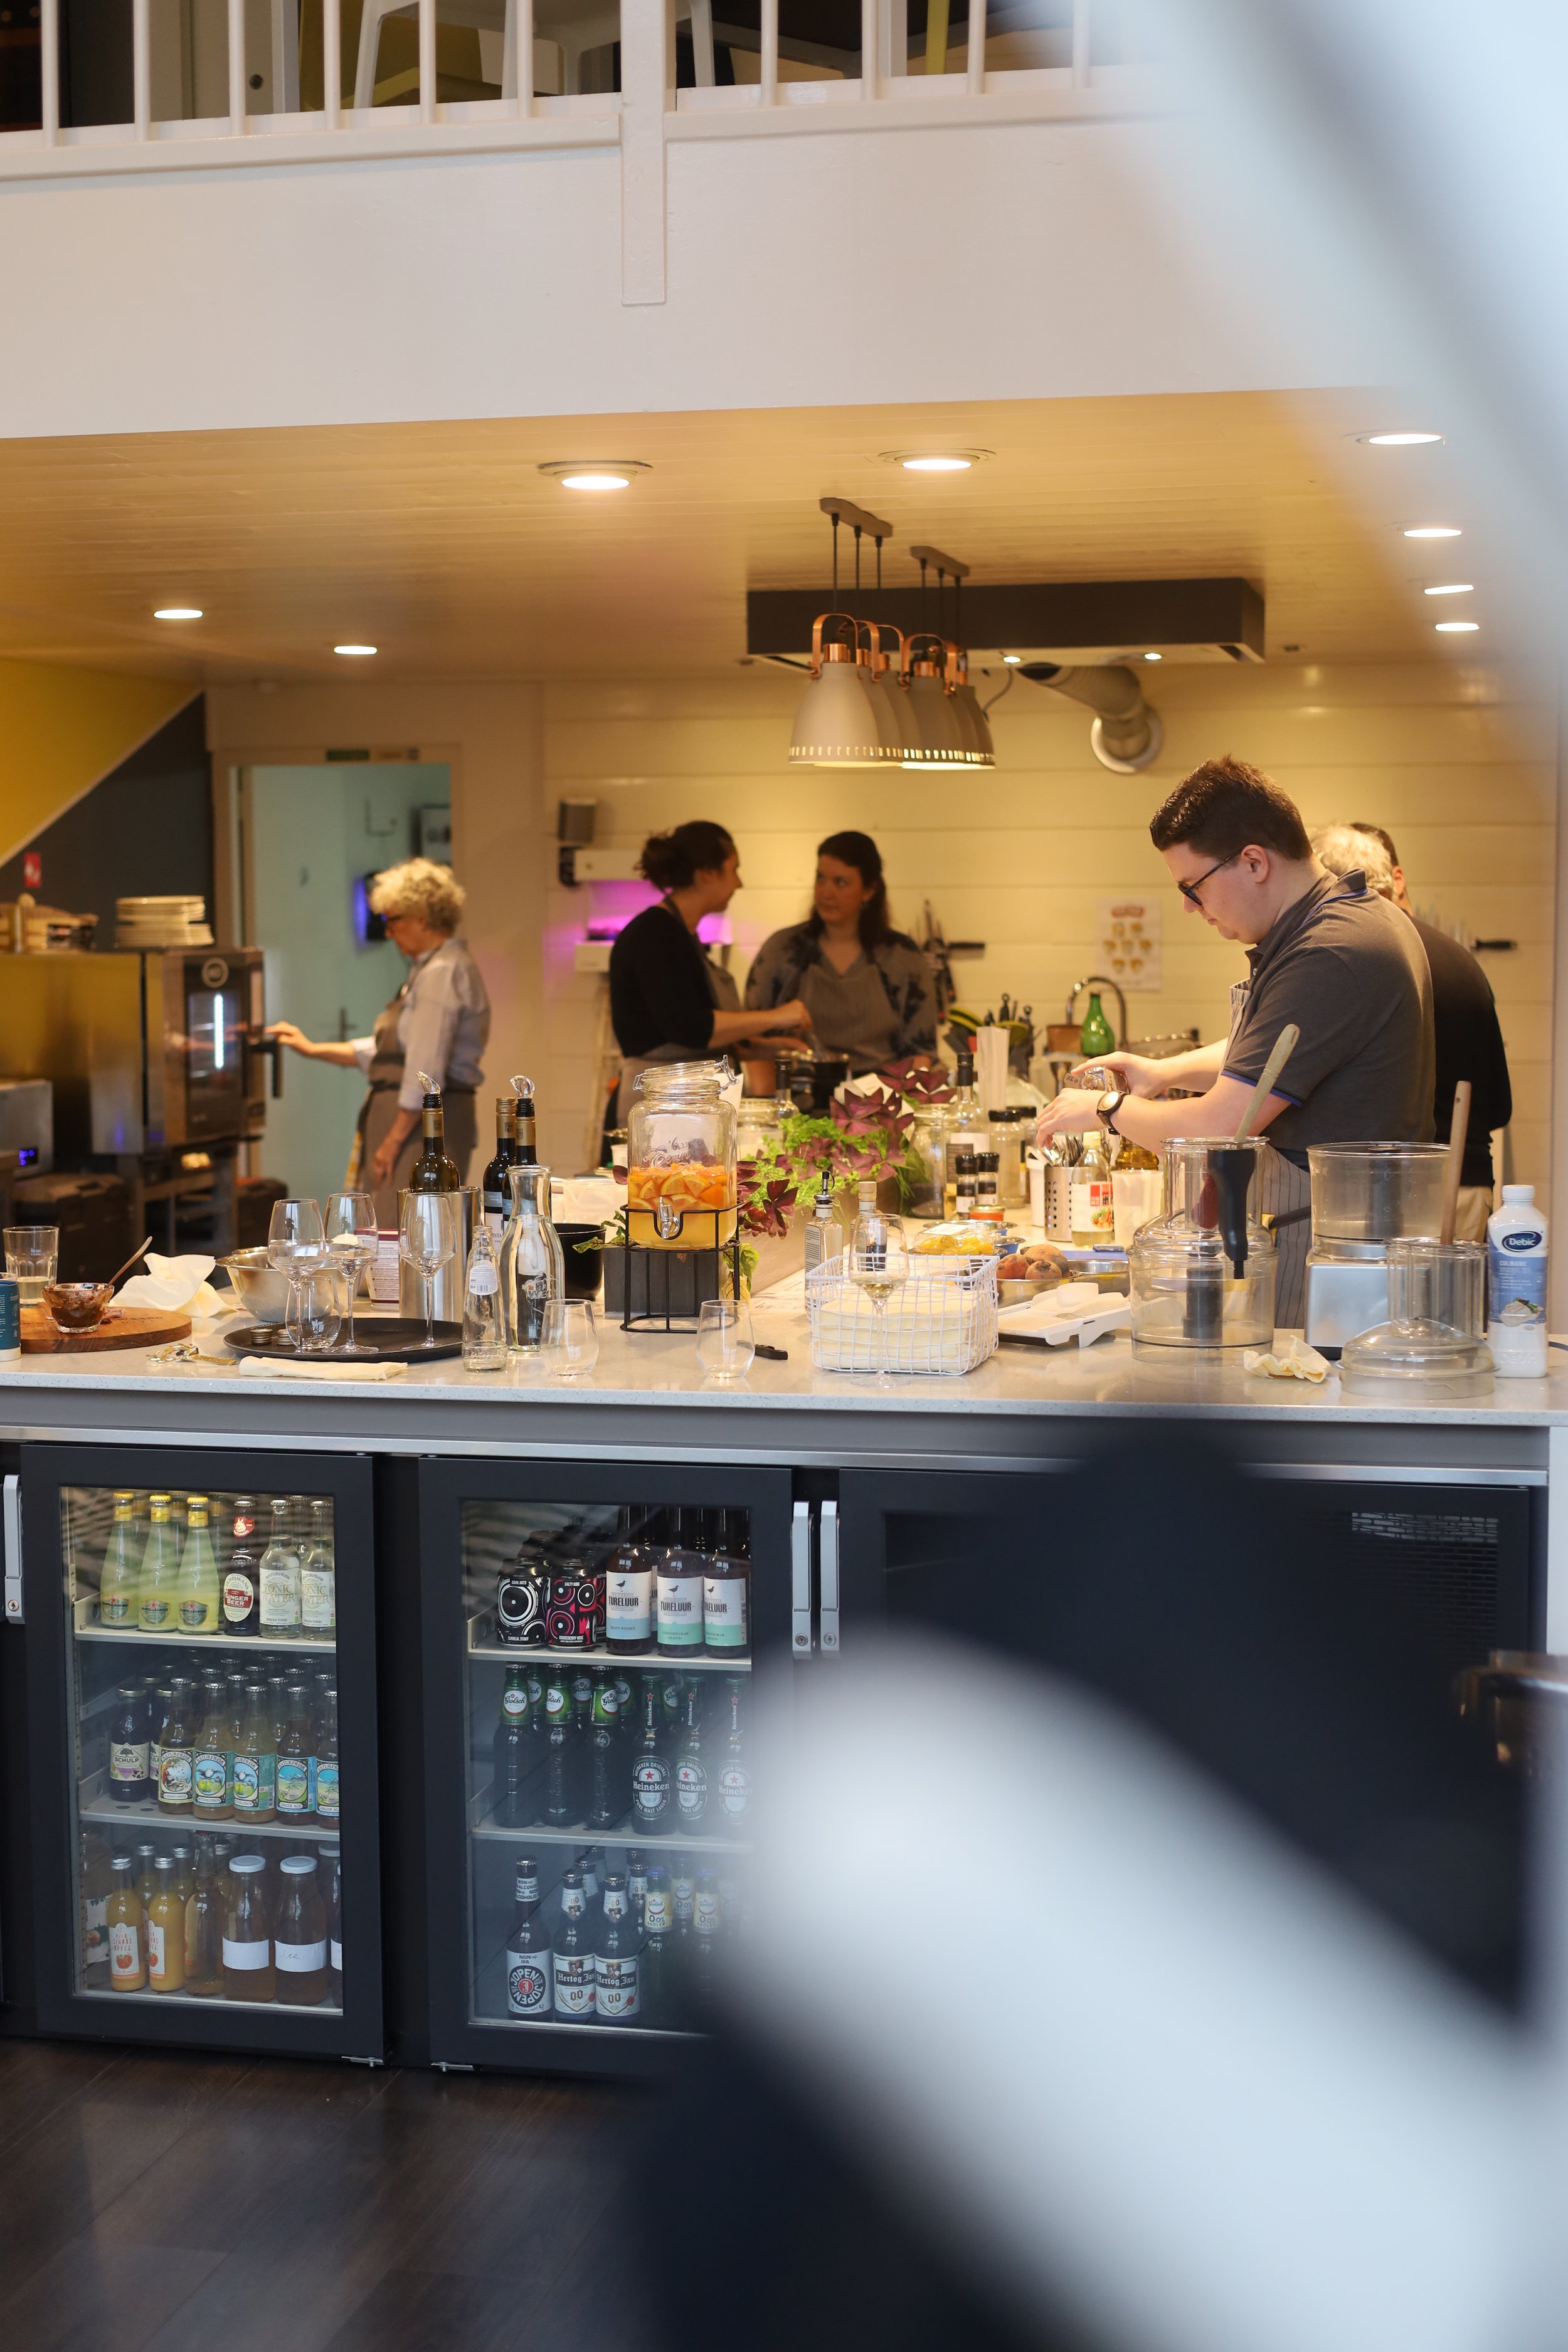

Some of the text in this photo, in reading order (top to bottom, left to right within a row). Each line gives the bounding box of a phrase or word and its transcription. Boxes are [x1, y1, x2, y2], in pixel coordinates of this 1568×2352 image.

[1508, 1237, 1536, 1246] Debic
[265, 1571, 290, 1580] NATURFRISK
[225, 1576, 249, 1591] FENTIMANS
[262, 1582, 293, 1594] TONIC
[304, 1584, 327, 1595] ONIC
[225, 1592, 249, 1601] GINGER
[262, 1593, 295, 1603] WATER
[304, 1595, 331, 1604] ATER
[608, 1596, 639, 1606] TURELUUR
[660, 1601, 692, 1611] TURELUUR
[706, 1602, 728, 1613] RELUUR
[504, 1695, 526, 1705] Grolsch
[548, 1695, 562, 1703] olsch
[602, 1695, 617, 1706] Grol
[163, 1751, 189, 1761] NATURFRISK
[196, 1755, 225, 1765] NATURFRISK
[279, 1761, 305, 1771] NATURFRISK
[634, 1762, 667, 1777] HEINEKEN ORIGINAL
[687, 1762, 704, 1778] ORIGINAL
[633, 1781, 670, 1791] Heineken
[677, 1781, 707, 1791] eineken
[635, 1799, 644, 1811] PURE
[656, 1799, 667, 1812] LAGER
[692, 1800, 704, 1813] LAGER
[511, 1968, 540, 1986] JOPEN
[557, 1972, 583, 1984] Hertog
[596, 1974, 635, 1987] Hertog Jan
[513, 1985, 544, 2005] JOPEN
